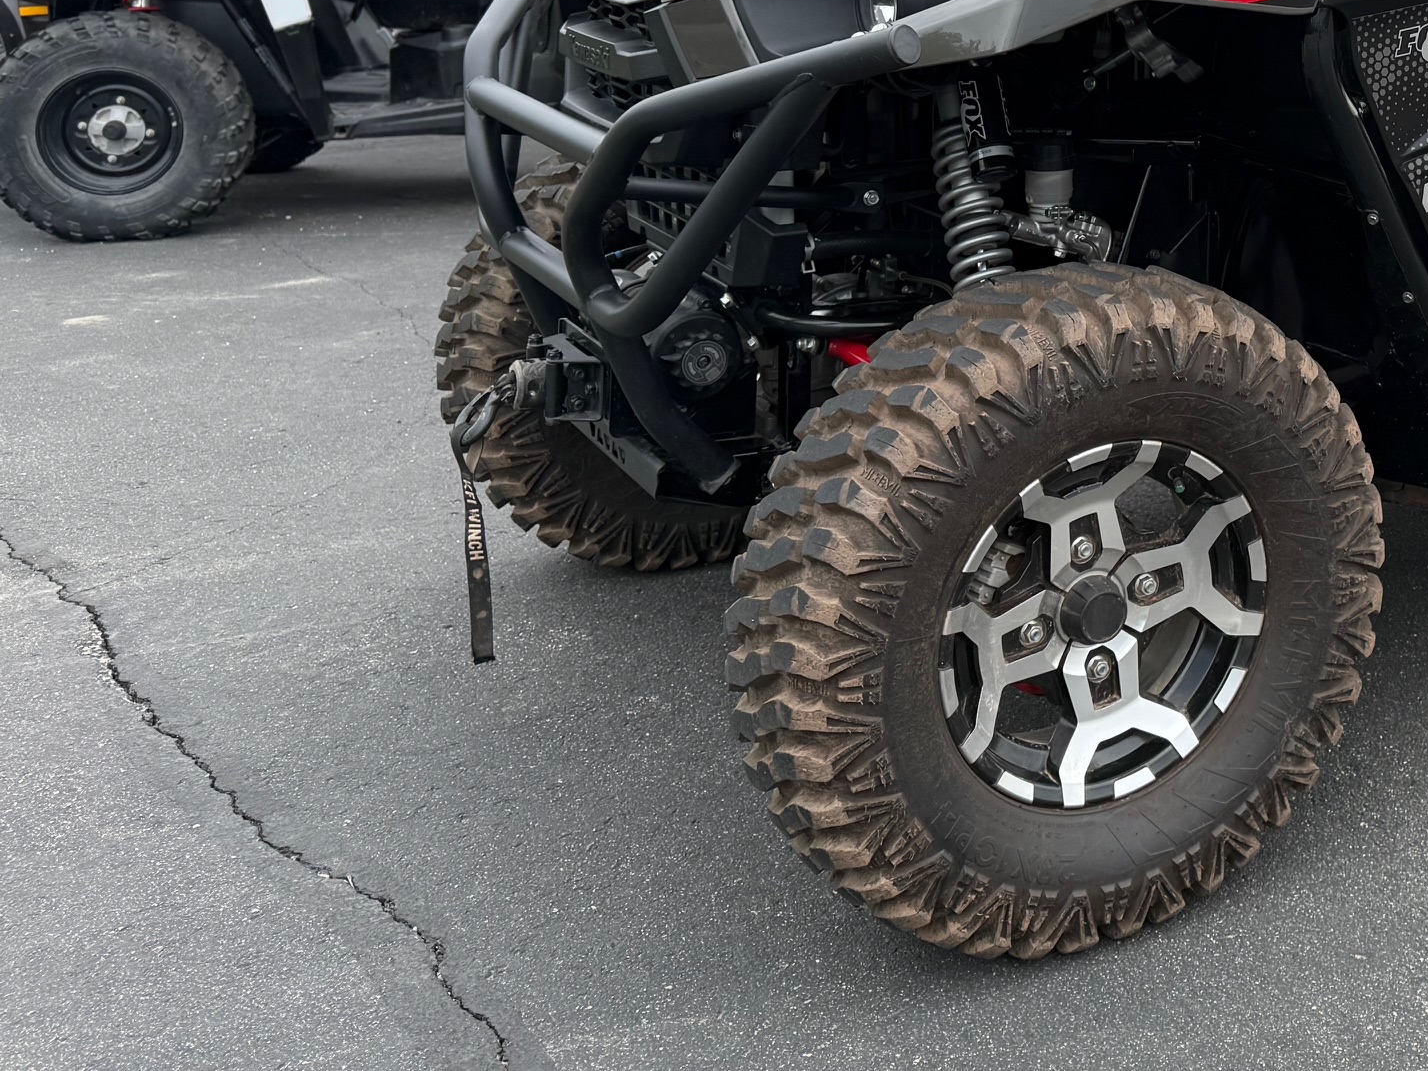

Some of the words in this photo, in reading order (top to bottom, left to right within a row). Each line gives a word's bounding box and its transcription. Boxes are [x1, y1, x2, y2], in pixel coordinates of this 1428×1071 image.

[958, 80, 986, 146] FOX
[463, 478, 477, 505] KFI
[467, 509, 485, 561] WINCH
